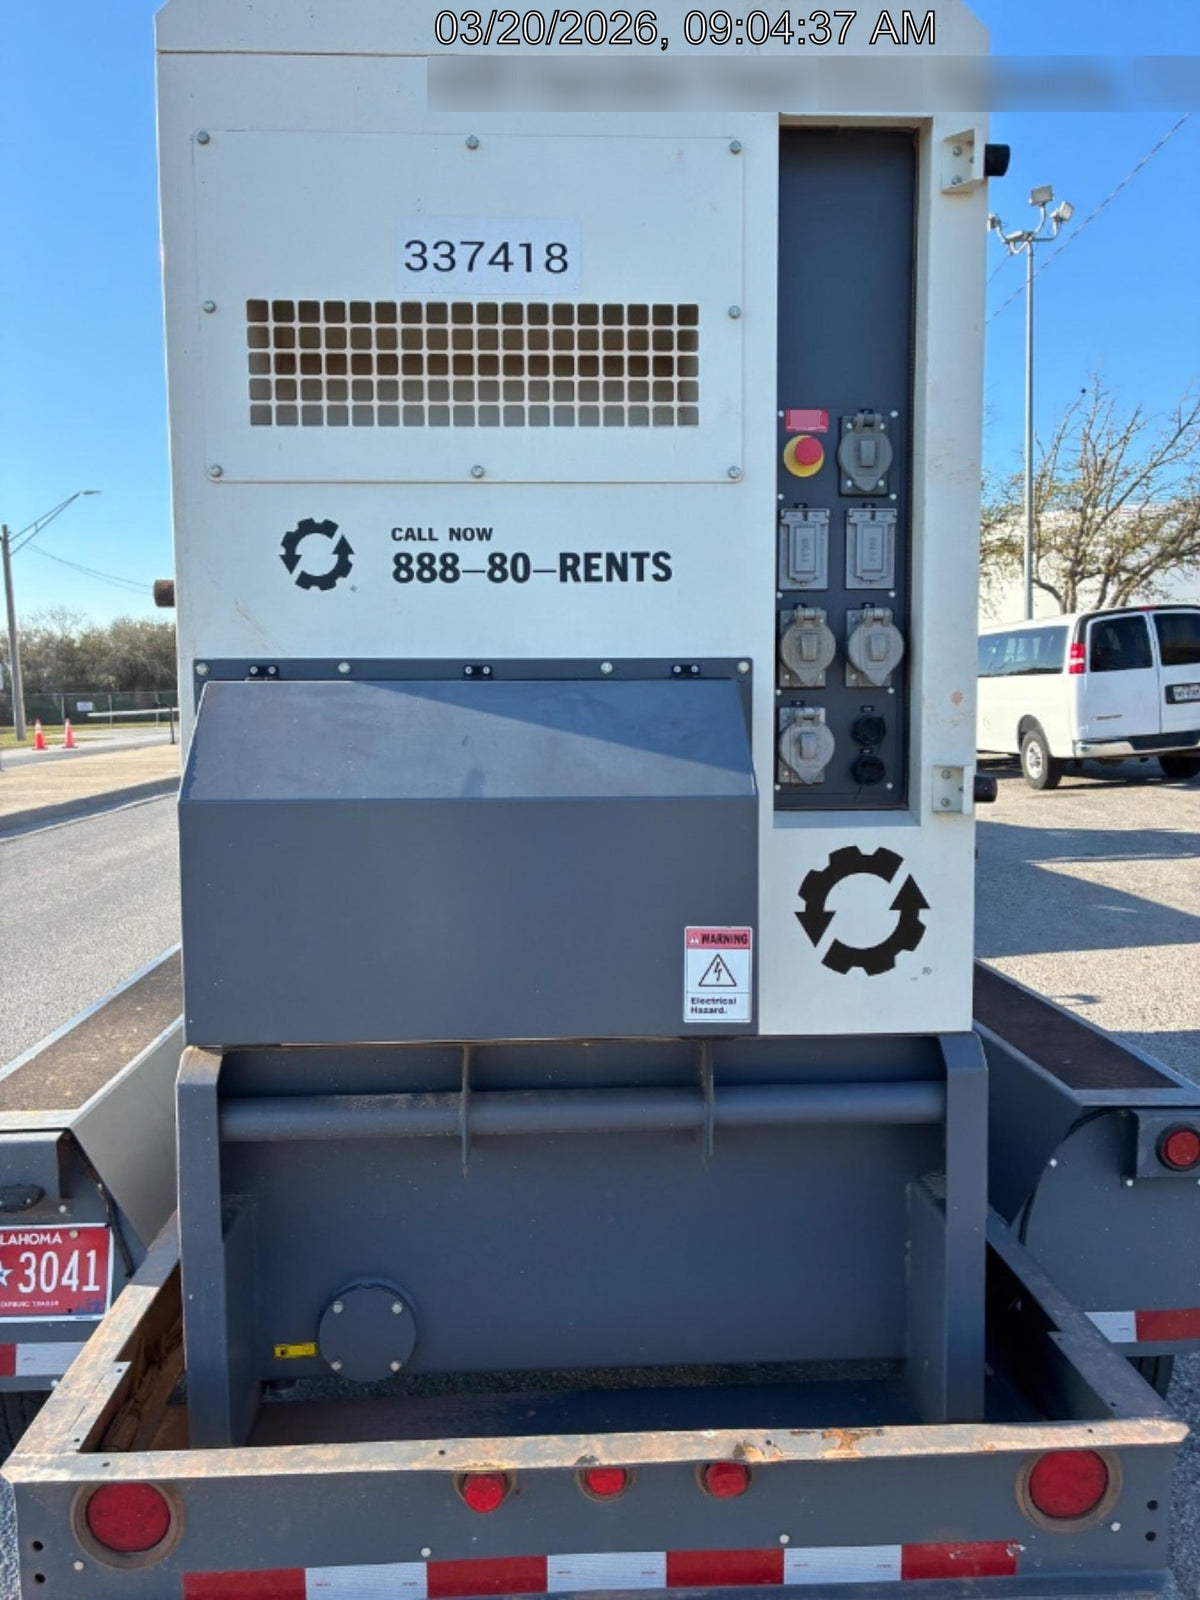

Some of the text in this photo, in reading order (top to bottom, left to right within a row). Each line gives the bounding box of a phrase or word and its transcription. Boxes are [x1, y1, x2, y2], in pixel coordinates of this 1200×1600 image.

[404, 239, 569, 274] 337418
[391, 527, 494, 542] CALL NOW
[701, 933, 748, 945] WARNING
[690, 997, 737, 1005] Electrical
[690, 1006, 728, 1014] Hazard.
[0, 1232, 63, 1246] LAHOMA
[17, 1249, 101, 1294] 3041
